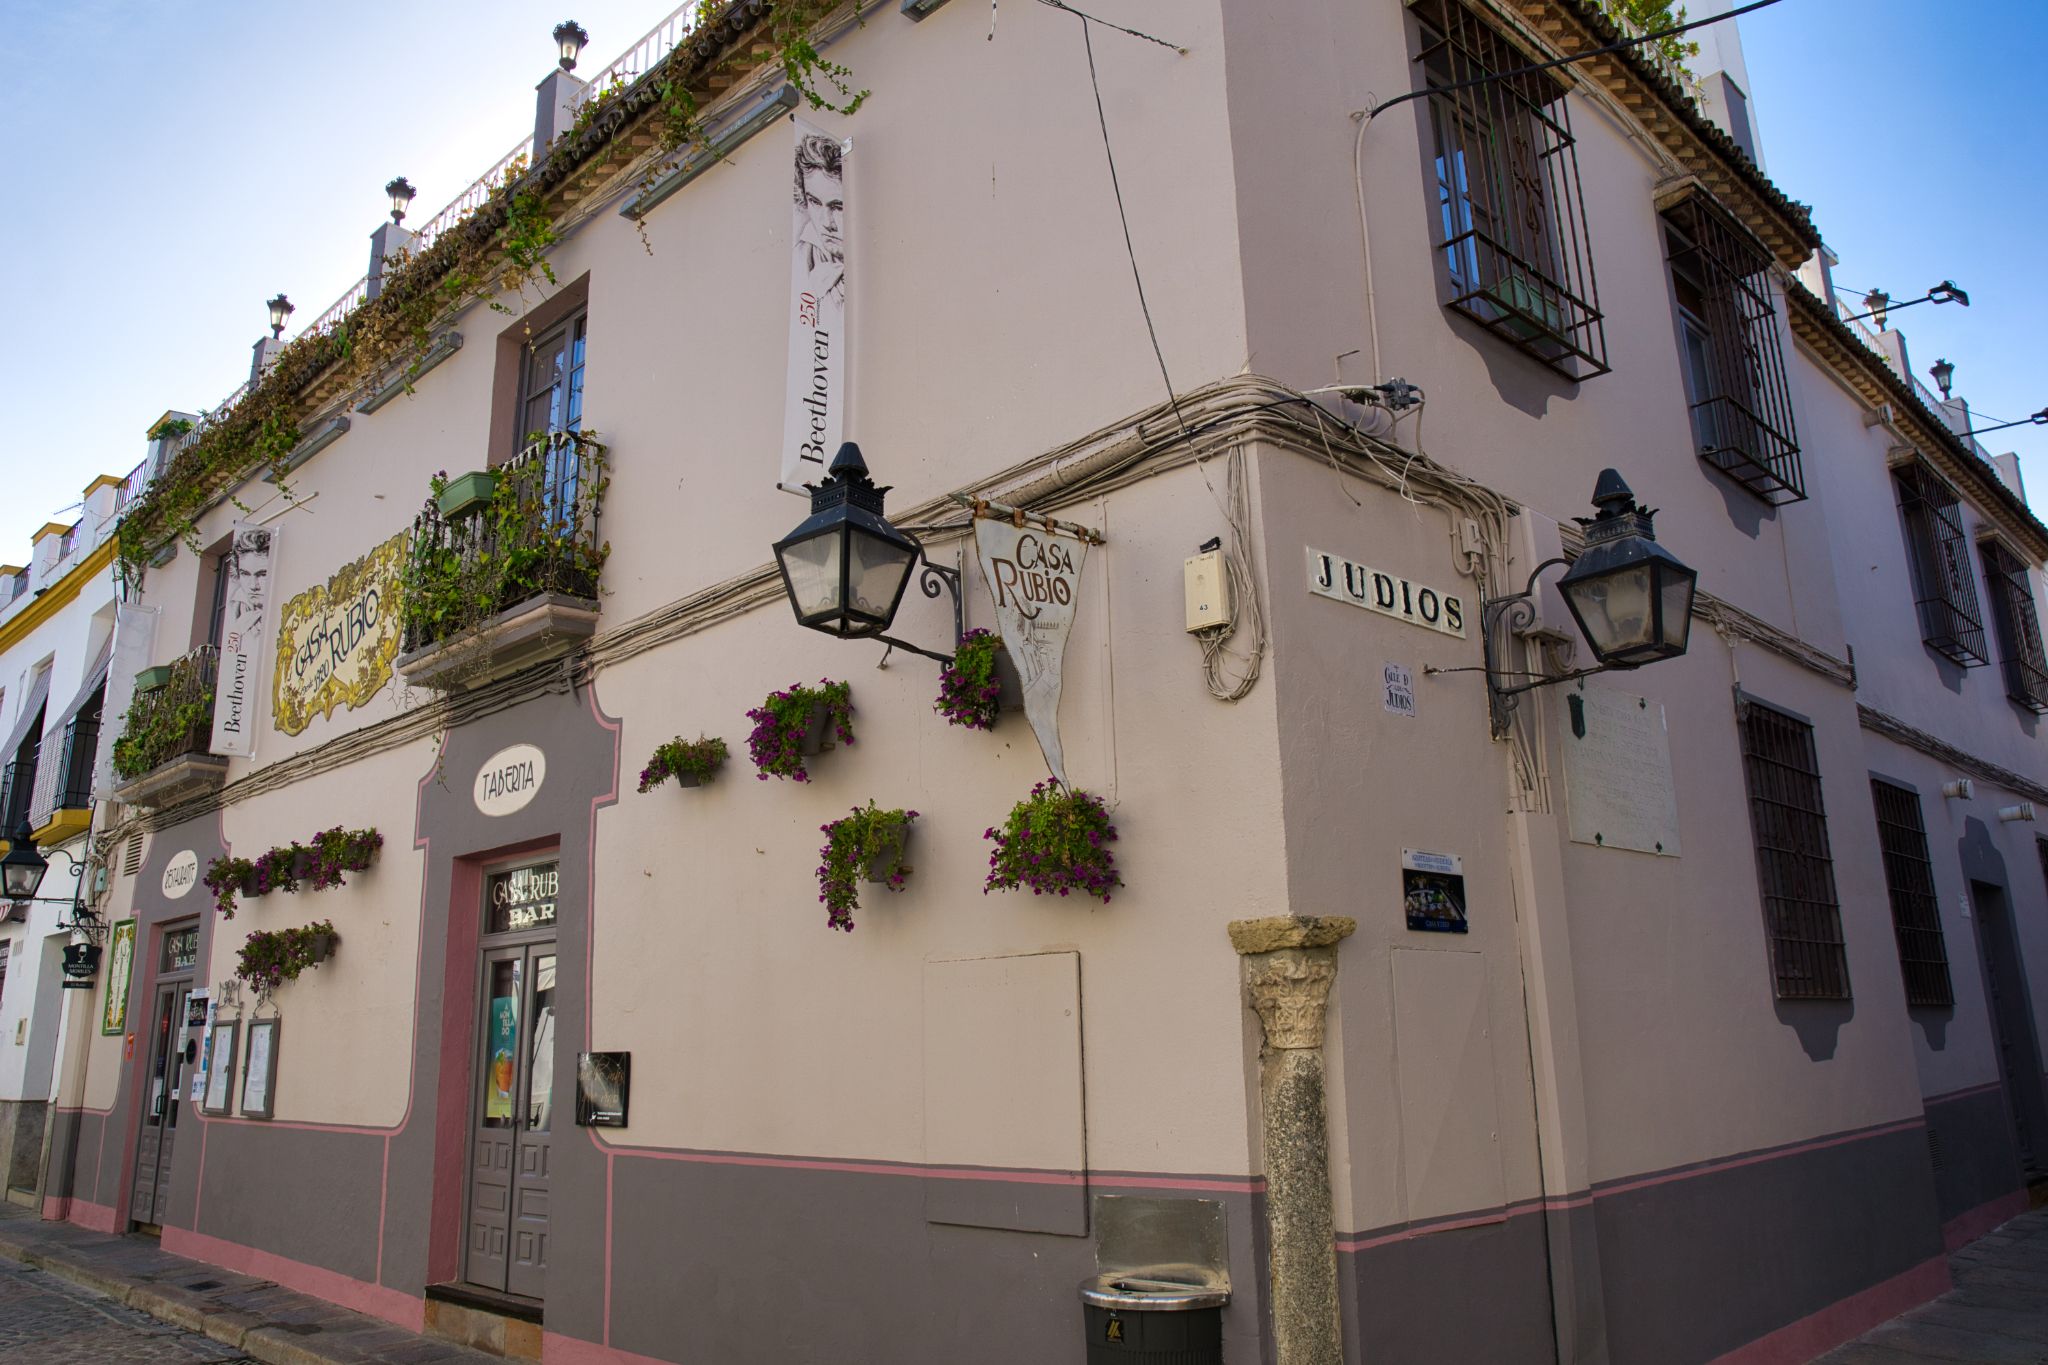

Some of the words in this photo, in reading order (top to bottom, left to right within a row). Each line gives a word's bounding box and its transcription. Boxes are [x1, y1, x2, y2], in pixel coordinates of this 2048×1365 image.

[800, 292, 817, 328] 250
[800, 330, 829, 466] Beethoven
[1016, 534, 1075, 575] CASA
[991, 557, 1071, 620] RUBIO
[1318, 554, 1463, 630] JUDIOS
[227, 632, 240, 653] 250
[295, 612, 330, 677] CASA
[330, 588, 379, 671] RUBIO
[223, 653, 248, 734] Beethoven
[1386, 689, 1412, 711] JUDIOS
[482, 760, 535, 801] TABERNA
[492, 875, 527, 912] CASA
[508, 903, 556, 926] BAR
[174, 954, 196, 968] BAR
